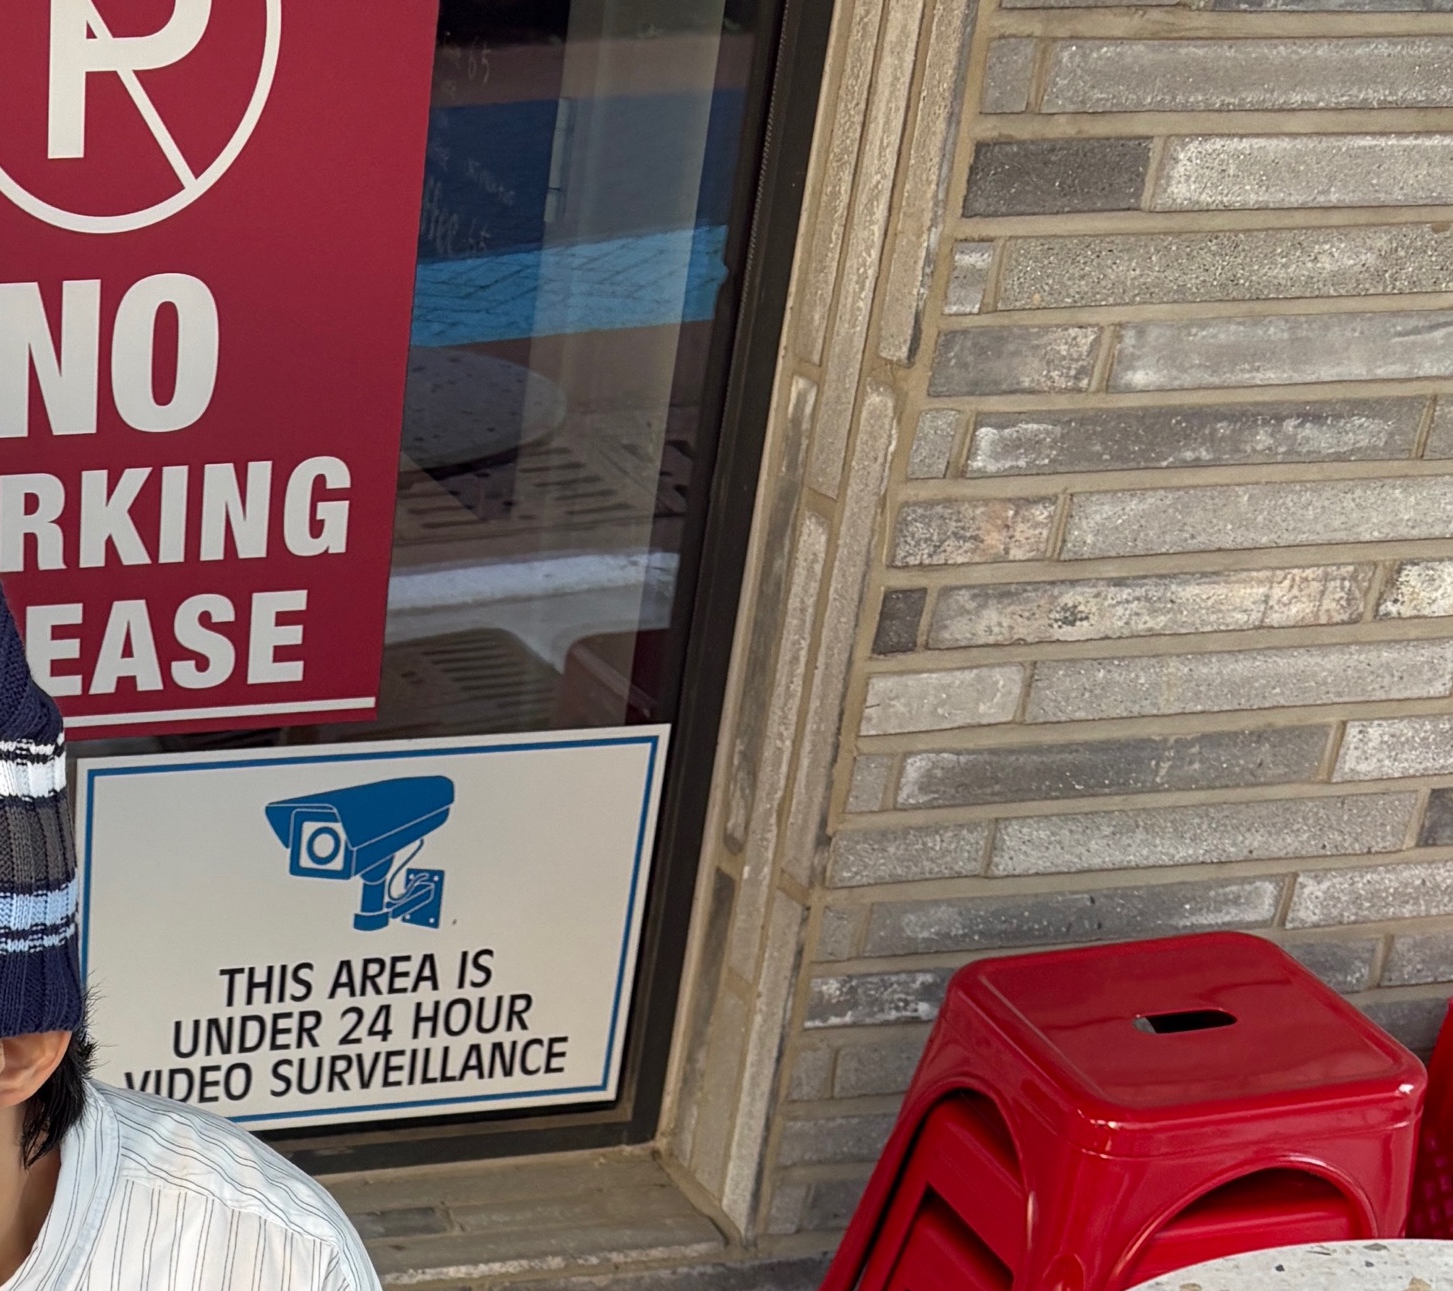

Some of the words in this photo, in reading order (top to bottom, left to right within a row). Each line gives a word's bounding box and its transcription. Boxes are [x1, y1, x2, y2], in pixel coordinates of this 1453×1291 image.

[25, 589, 308, 697] EASE
[219, 962, 314, 1008] THIS
[327, 953, 440, 1000] AREA
[457, 948, 495, 990] IS
[173, 1010, 323, 1059] UNDER
[338, 1003, 393, 1046] 24
[412, 993, 533, 1040] HOUR
[270, 1036, 569, 1098] SURVEILLANCE
